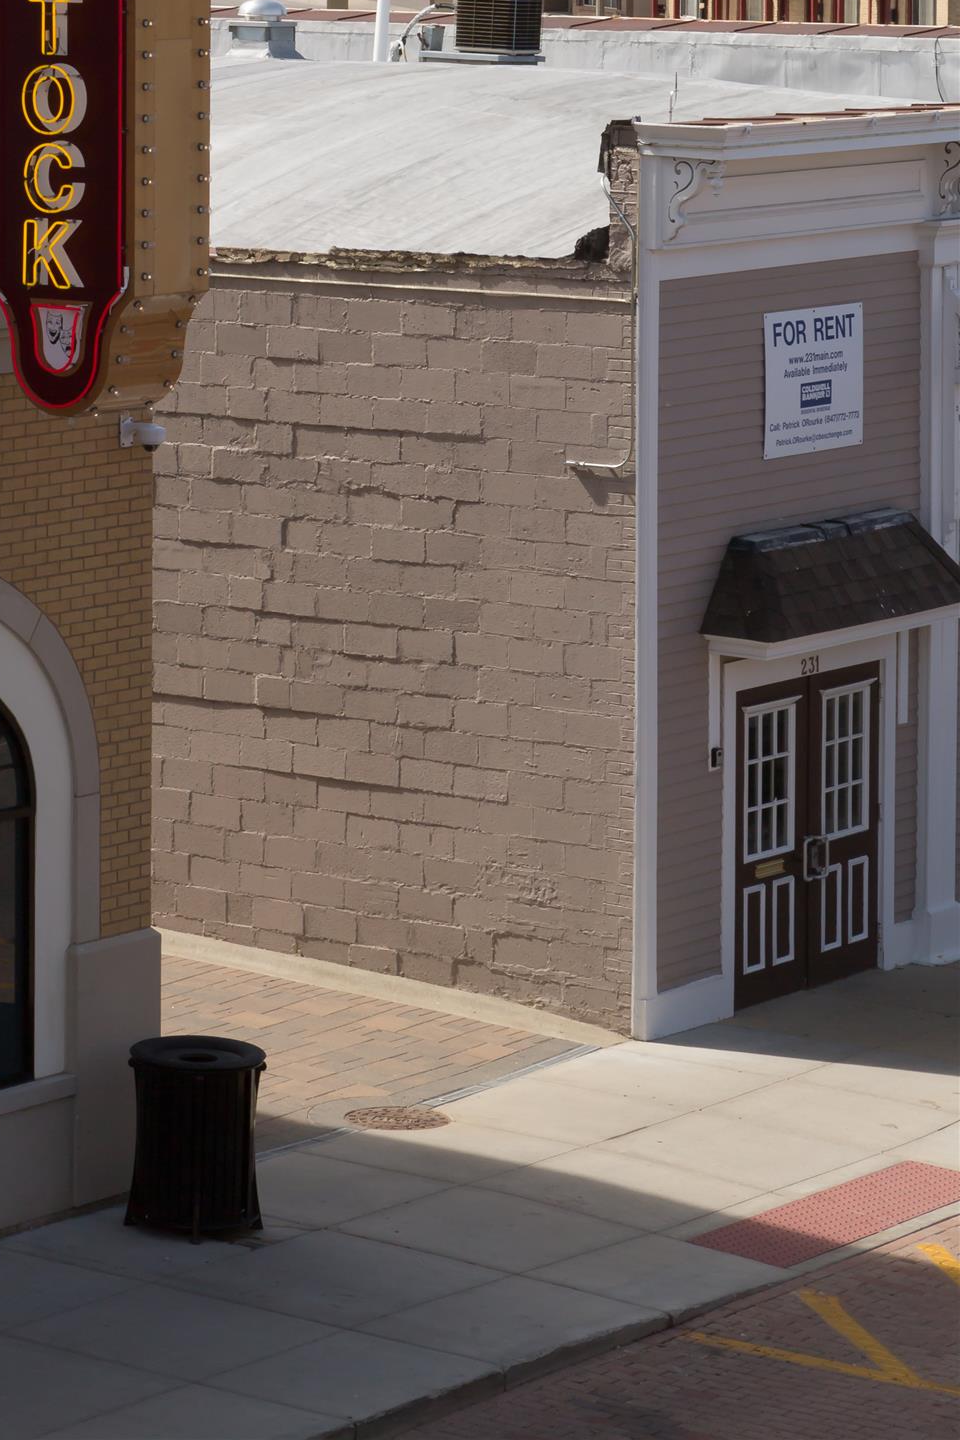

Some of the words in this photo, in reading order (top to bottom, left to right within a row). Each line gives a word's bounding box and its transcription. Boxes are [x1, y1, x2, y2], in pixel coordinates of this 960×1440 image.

[772, 319, 807, 347] FOR
[813, 313, 855, 342] RENT
[783, 367, 811, 379] Available
[812, 361, 848, 375] Immediately
[801, 655, 819, 675] 231
